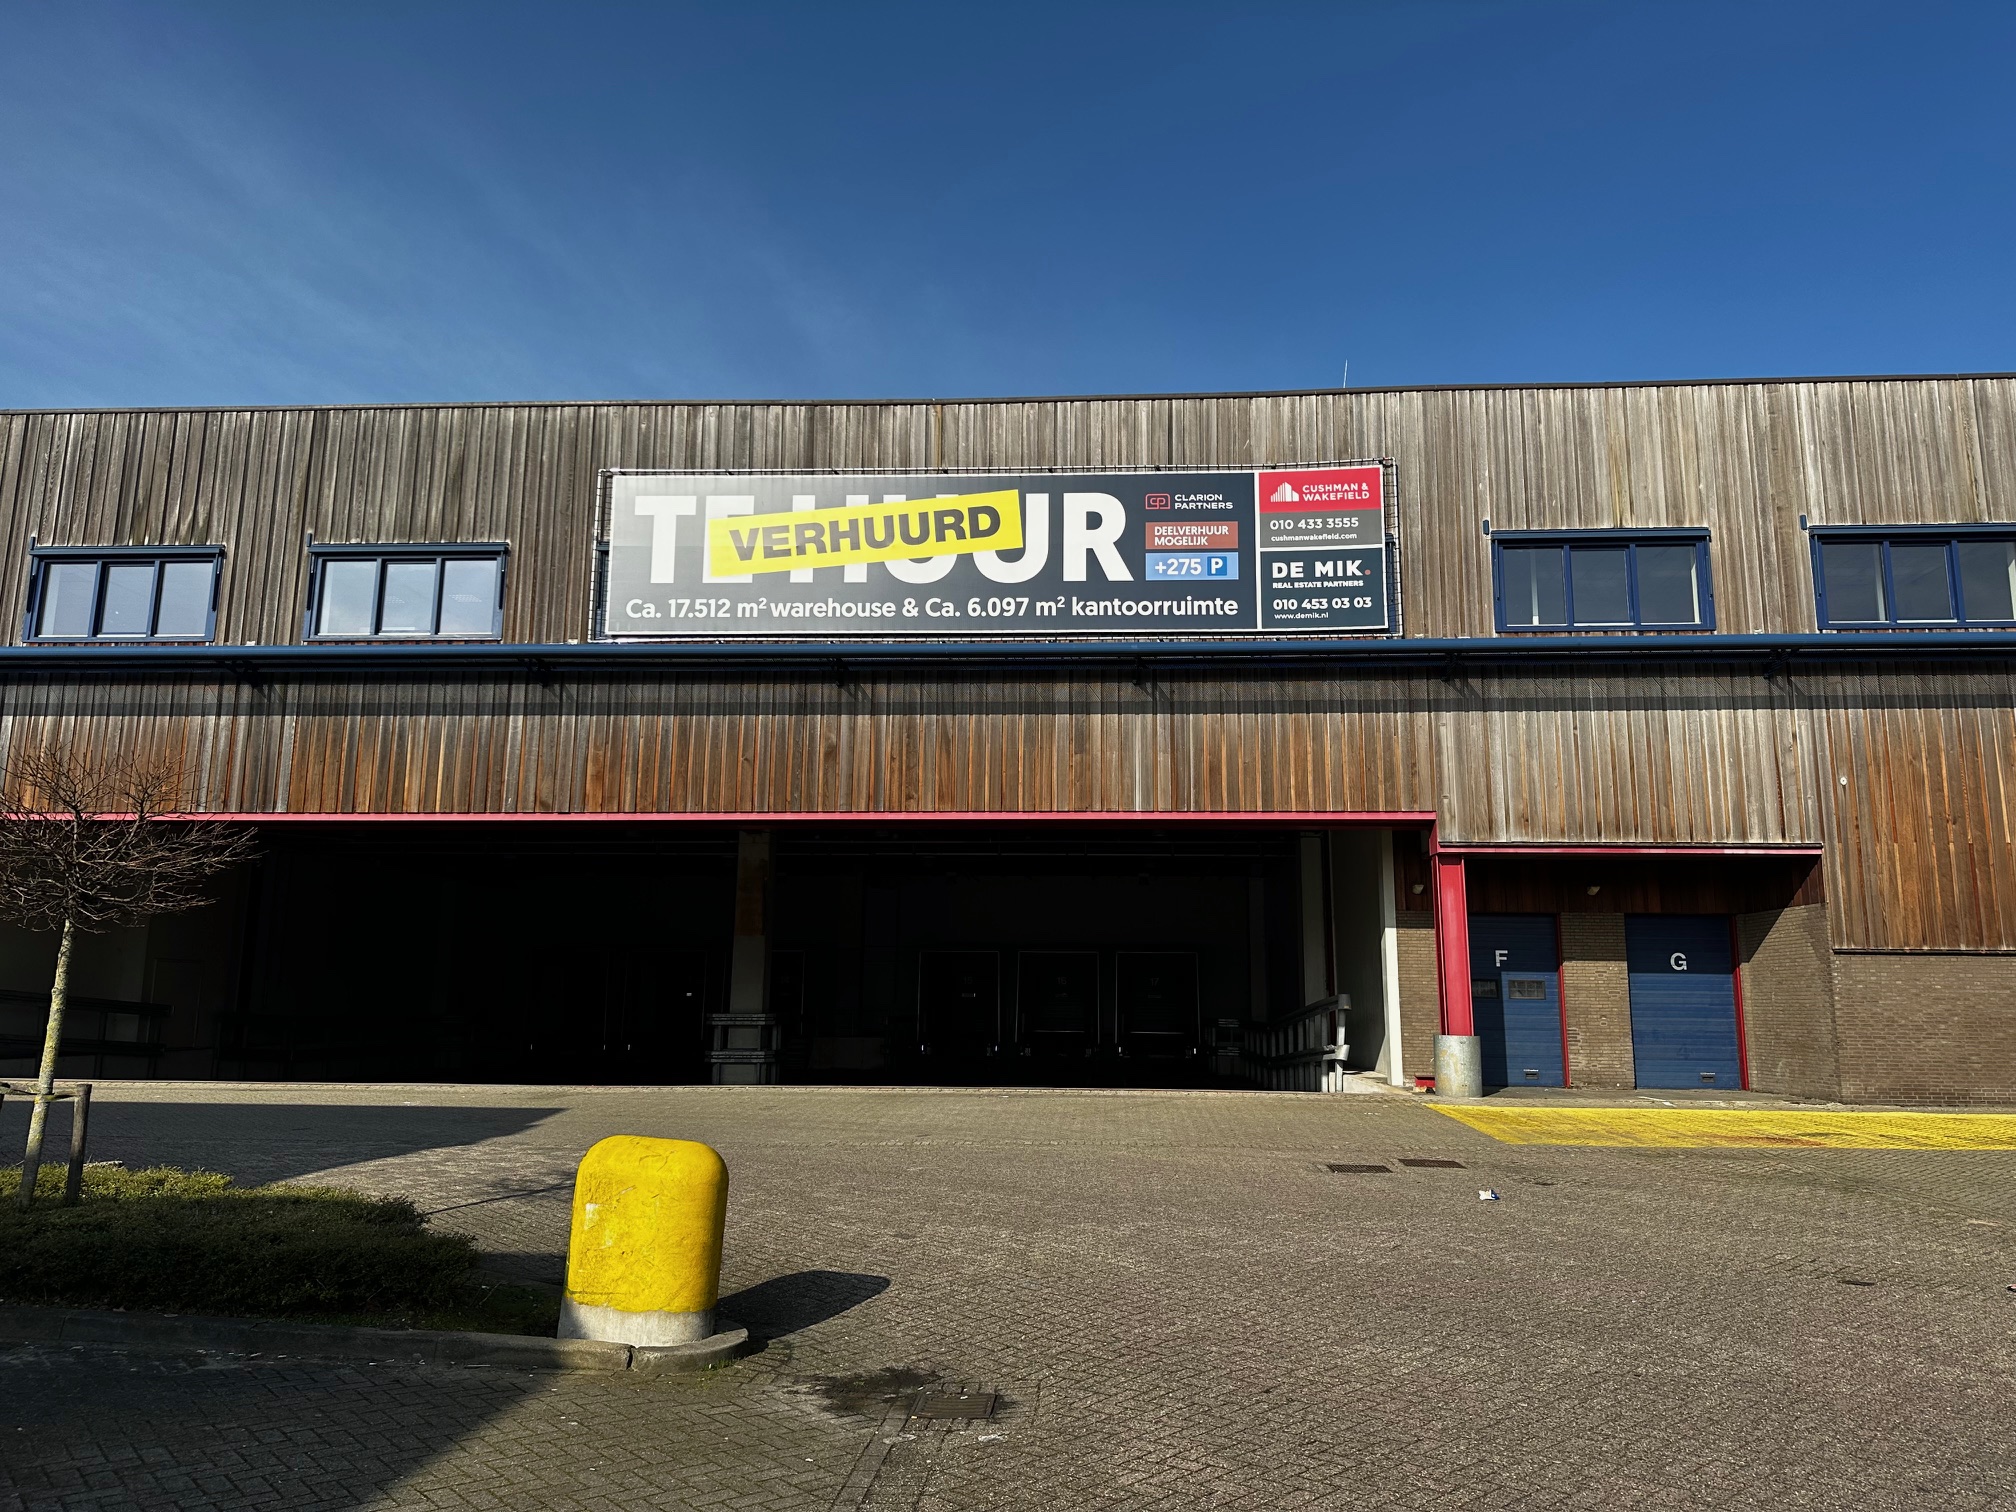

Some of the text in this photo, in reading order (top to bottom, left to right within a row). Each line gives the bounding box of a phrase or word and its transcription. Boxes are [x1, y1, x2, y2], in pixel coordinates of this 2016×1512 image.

[1302, 482, 1369, 493] CUSHMAN &
[1174, 493, 1223, 502] CLARION
[1302, 491, 1370, 501] WAKEFIELD
[1174, 502, 1234, 510] PARTNERS
[1269, 517, 1359, 530] 010 433 3555
[729, 505, 1001, 562] VERHUURD
[1154, 525, 1229, 536] DEELVERHUUR
[1154, 536, 1208, 546] MOGELIJK
[1270, 533, 1357, 542] cushmanwakefield.com
[1154, 557, 1224, 575] +275 P
[1272, 561, 1304, 579] DE
[1323, 580, 1364, 588] PARTNERS
[625, 598, 662, 618] Ca.
[668, 598, 731, 618] 17.512
[770, 597, 896, 618] warehouse
[902, 597, 919, 617] &
[925, 597, 960, 617] Ca.
[967, 597, 1029, 617] 6.097
[1072, 595, 1239, 616] kantoorruimte
[1273, 596, 1372, 610] 010 453 03 03
[1494, 950, 1508, 967] F
[1670, 952, 1687, 971] G
